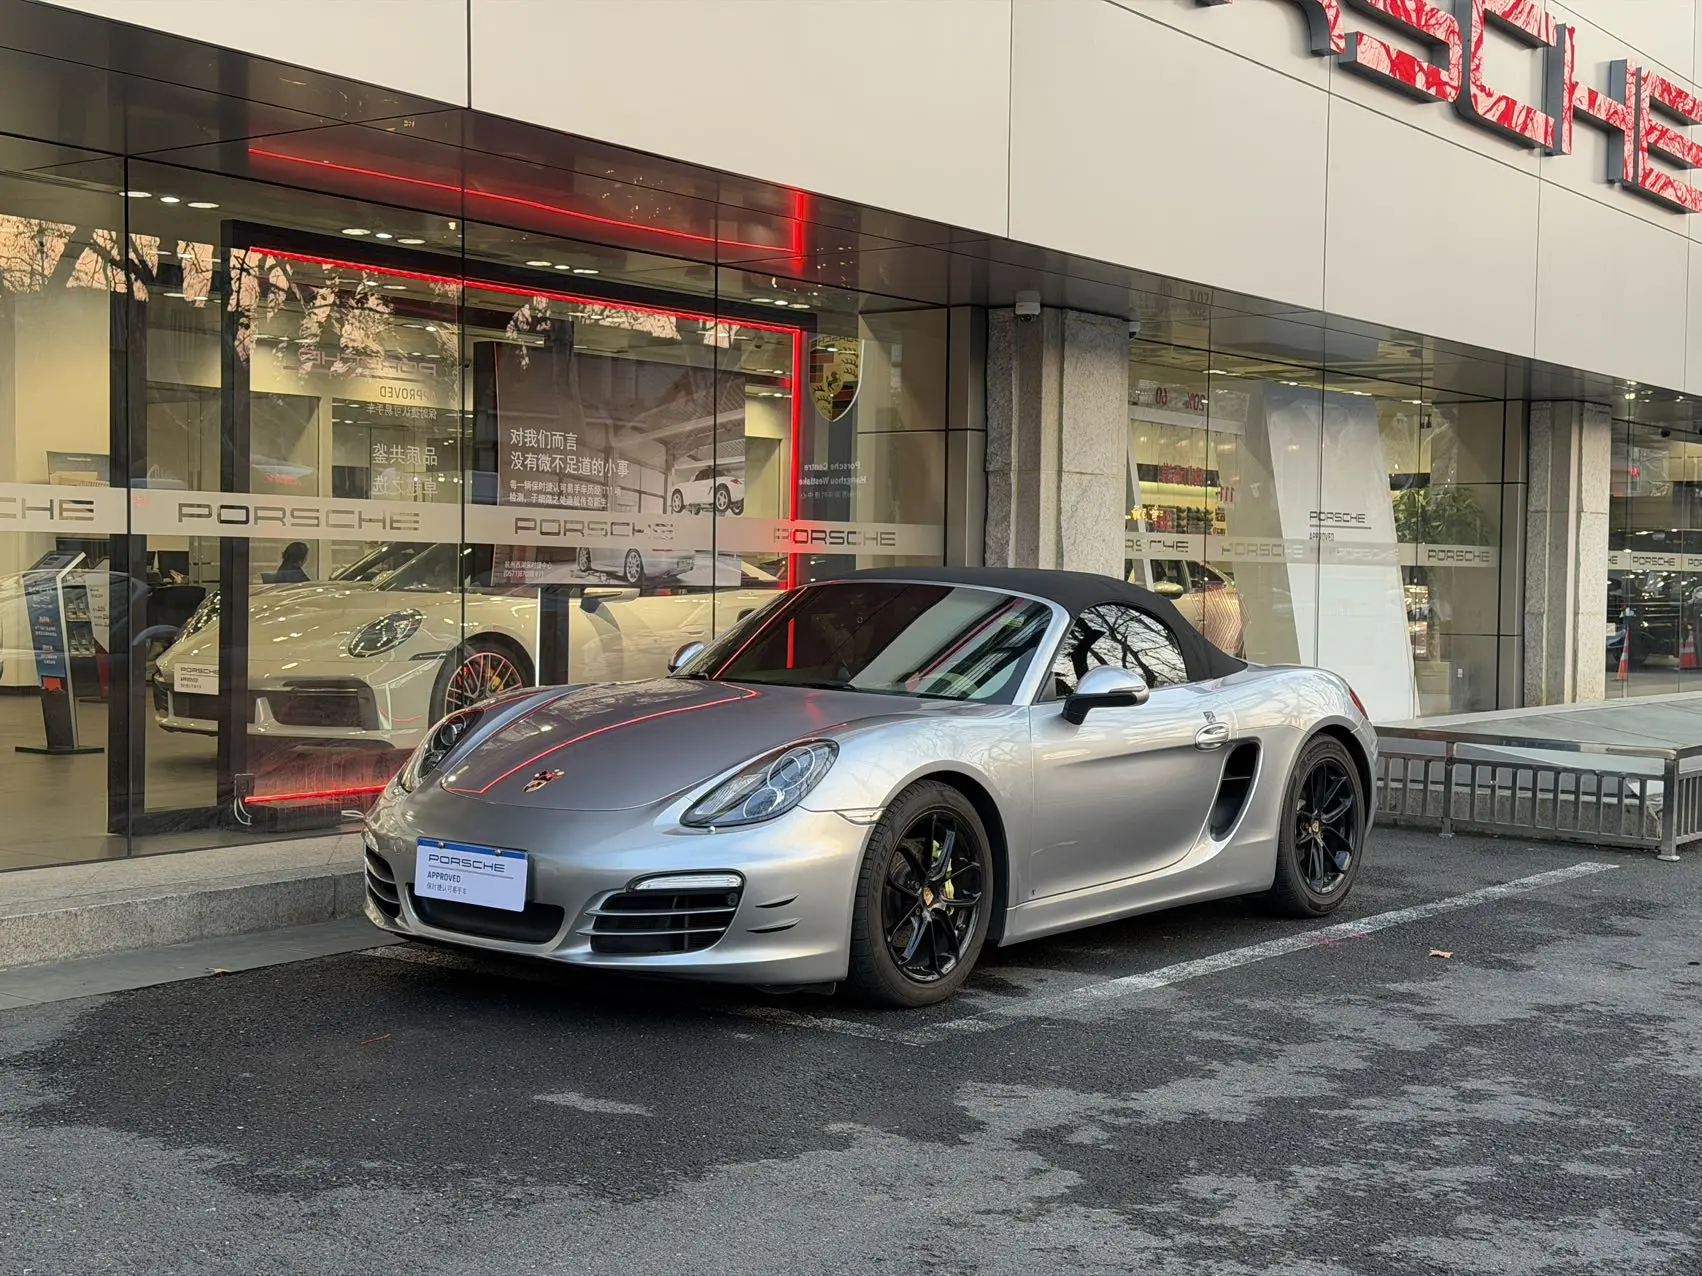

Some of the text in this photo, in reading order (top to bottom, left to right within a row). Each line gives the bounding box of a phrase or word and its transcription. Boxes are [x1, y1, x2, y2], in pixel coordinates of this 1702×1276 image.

[1196, 0, 1702, 214] SCHE
[510, 427, 578, 451] 对我们而言
[510, 451, 630, 477] 没有微不足道的小事
[178, 502, 420, 531] PORSCHE
[1309, 511, 1366, 524] PORSCHE
[514, 517, 674, 541] PORSCHE
[773, 527, 896, 547] PORSCHE
[1427, 549, 1491, 562] PORSCHE
[1633, 556, 1676, 567] PORSCHE
[428, 854, 505, 872] PORSCHE
[427, 871, 461, 884] APPROVED
